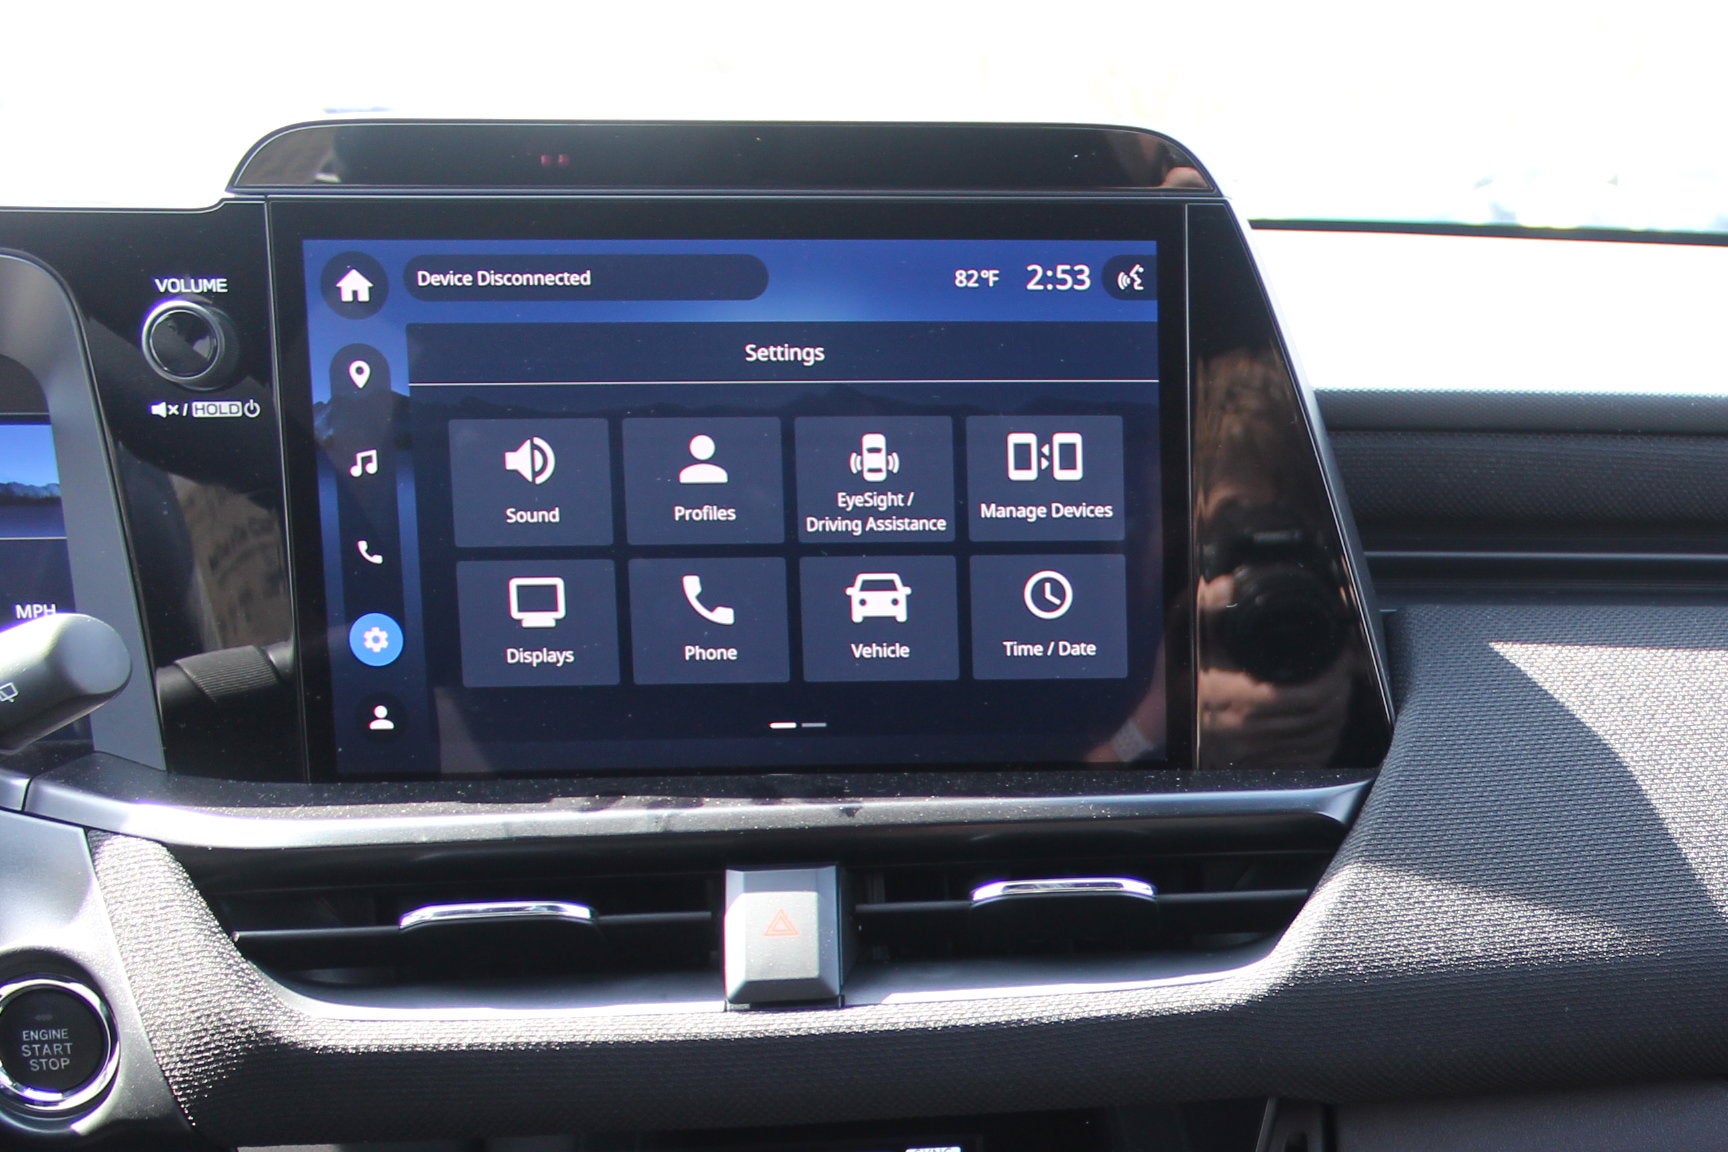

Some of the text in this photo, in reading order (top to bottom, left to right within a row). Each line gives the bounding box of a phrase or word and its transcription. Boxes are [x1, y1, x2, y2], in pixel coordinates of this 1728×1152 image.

[154, 278, 228, 293] VOLUME
[417, 269, 591, 286] Device Disconnected
[954, 269, 1000, 288] 82°F
[1026, 264, 1091, 291] 2:53
[745, 343, 825, 366] Settings
[193, 403, 242, 416] HOLD
[837, 491, 904, 511] EyeSight
[505, 507, 560, 523] Sound
[674, 504, 737, 522] Profiles
[980, 503, 1114, 522] Manage Devices
[806, 515, 947, 535] Driving Assistance
[15, 604, 56, 619] MPH
[684, 645, 738, 660] Phone
[851, 642, 910, 658] Vehicle
[1003, 641, 1044, 657] Time
[1058, 641, 1096, 656] Date
[506, 648, 574, 667] Displays
[22, 1028, 69, 1041] ENGINE
[22, 1043, 73, 1057] START
[30, 1058, 70, 1071] STOP
